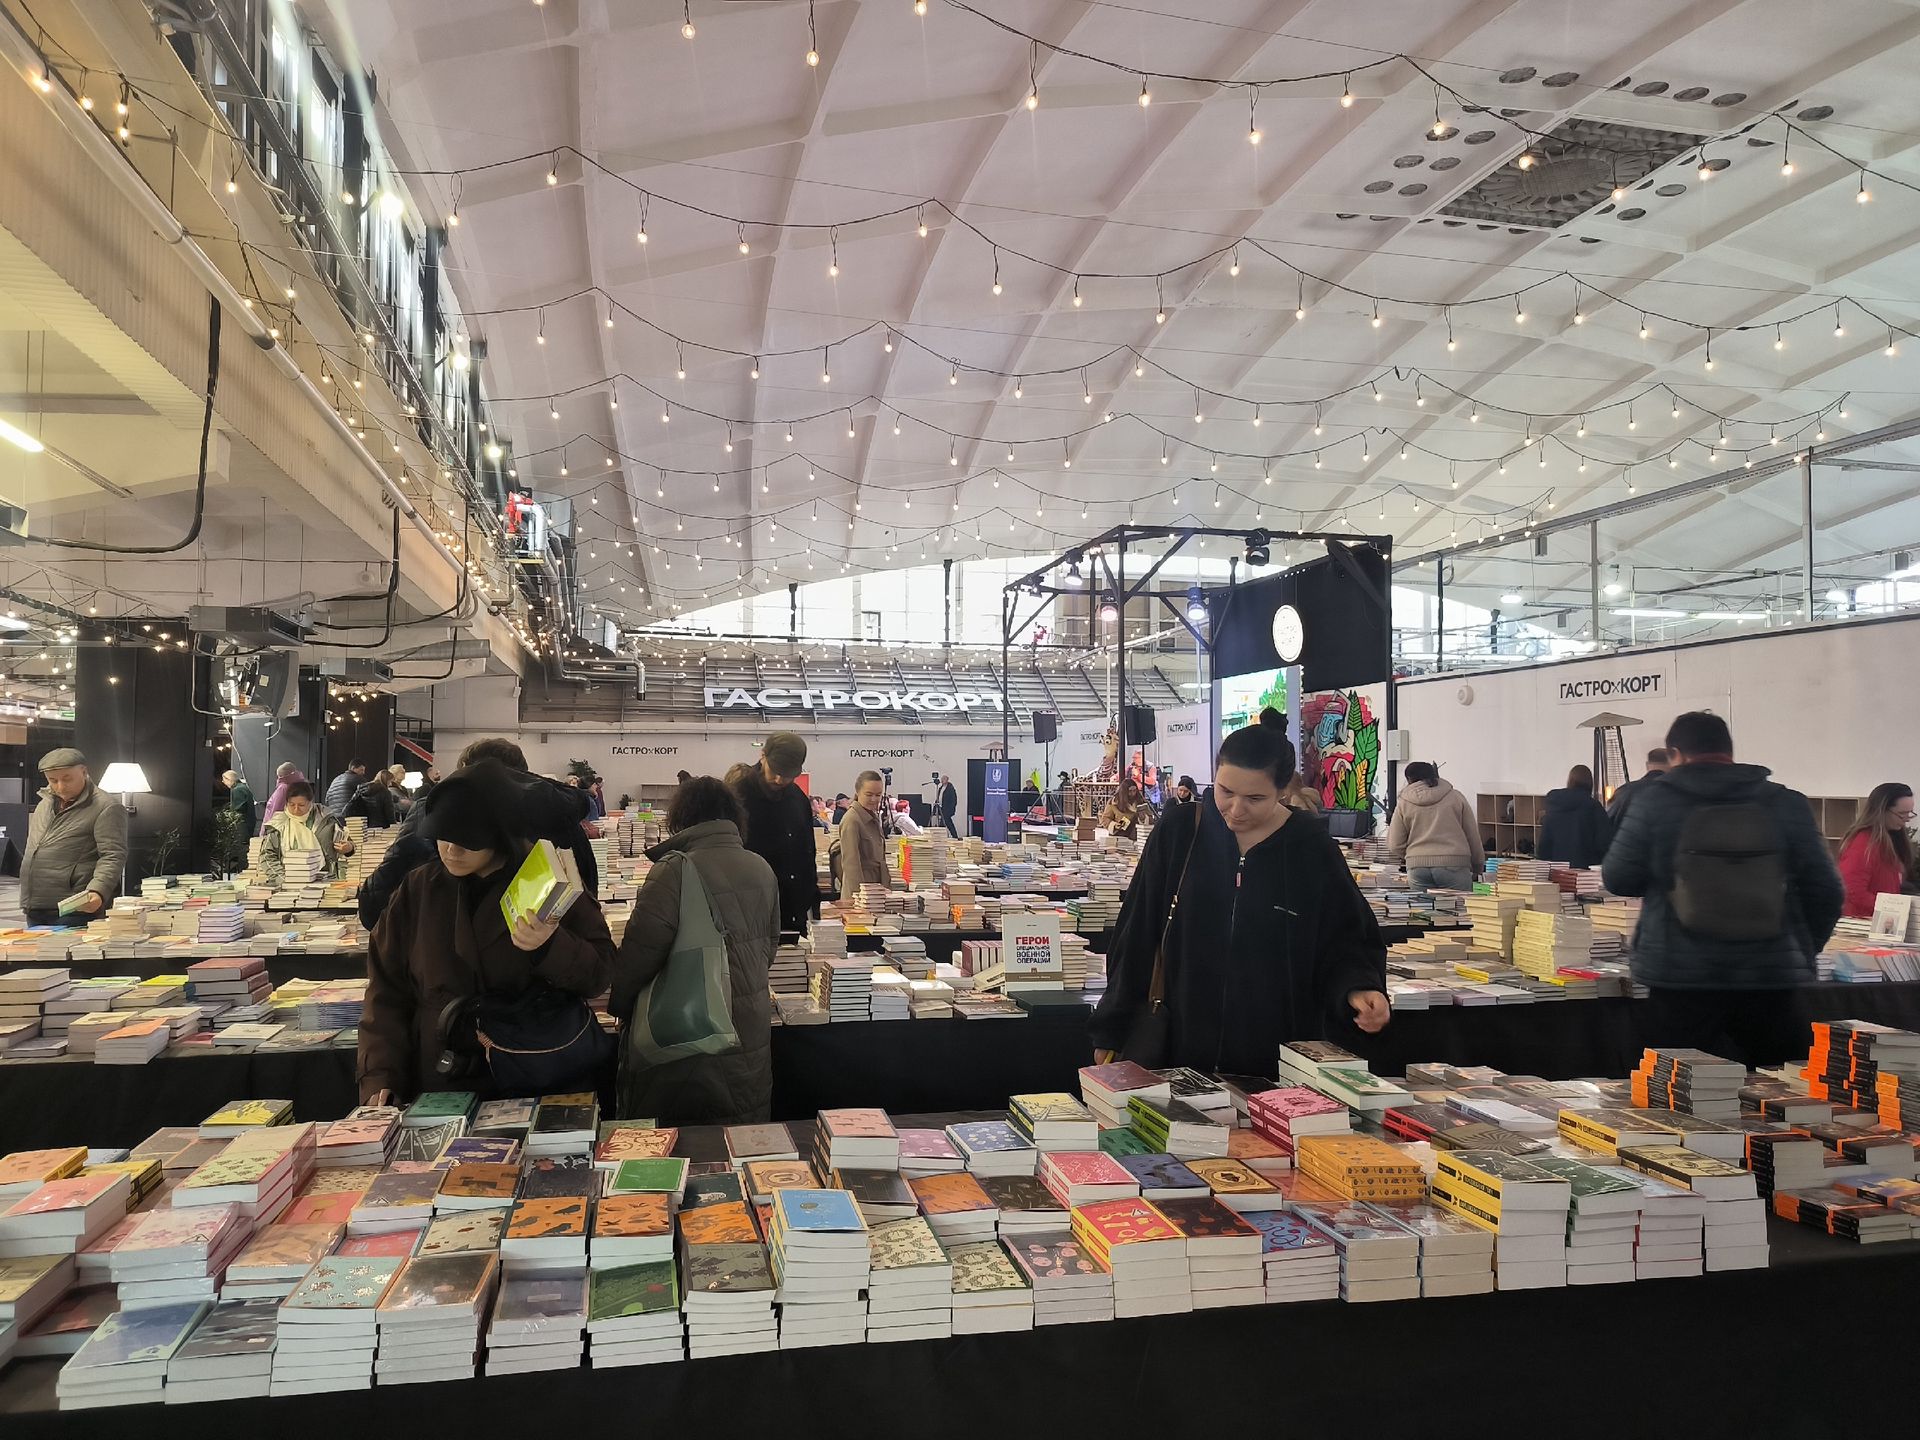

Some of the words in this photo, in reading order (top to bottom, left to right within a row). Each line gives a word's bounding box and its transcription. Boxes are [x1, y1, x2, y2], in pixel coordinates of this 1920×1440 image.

[703, 687, 1004, 711] ГАСТРОКОРТ
[1015, 936, 1050, 945] ГЕРОИ
[1016, 950, 1051, 958] ВОЕННОЙ
